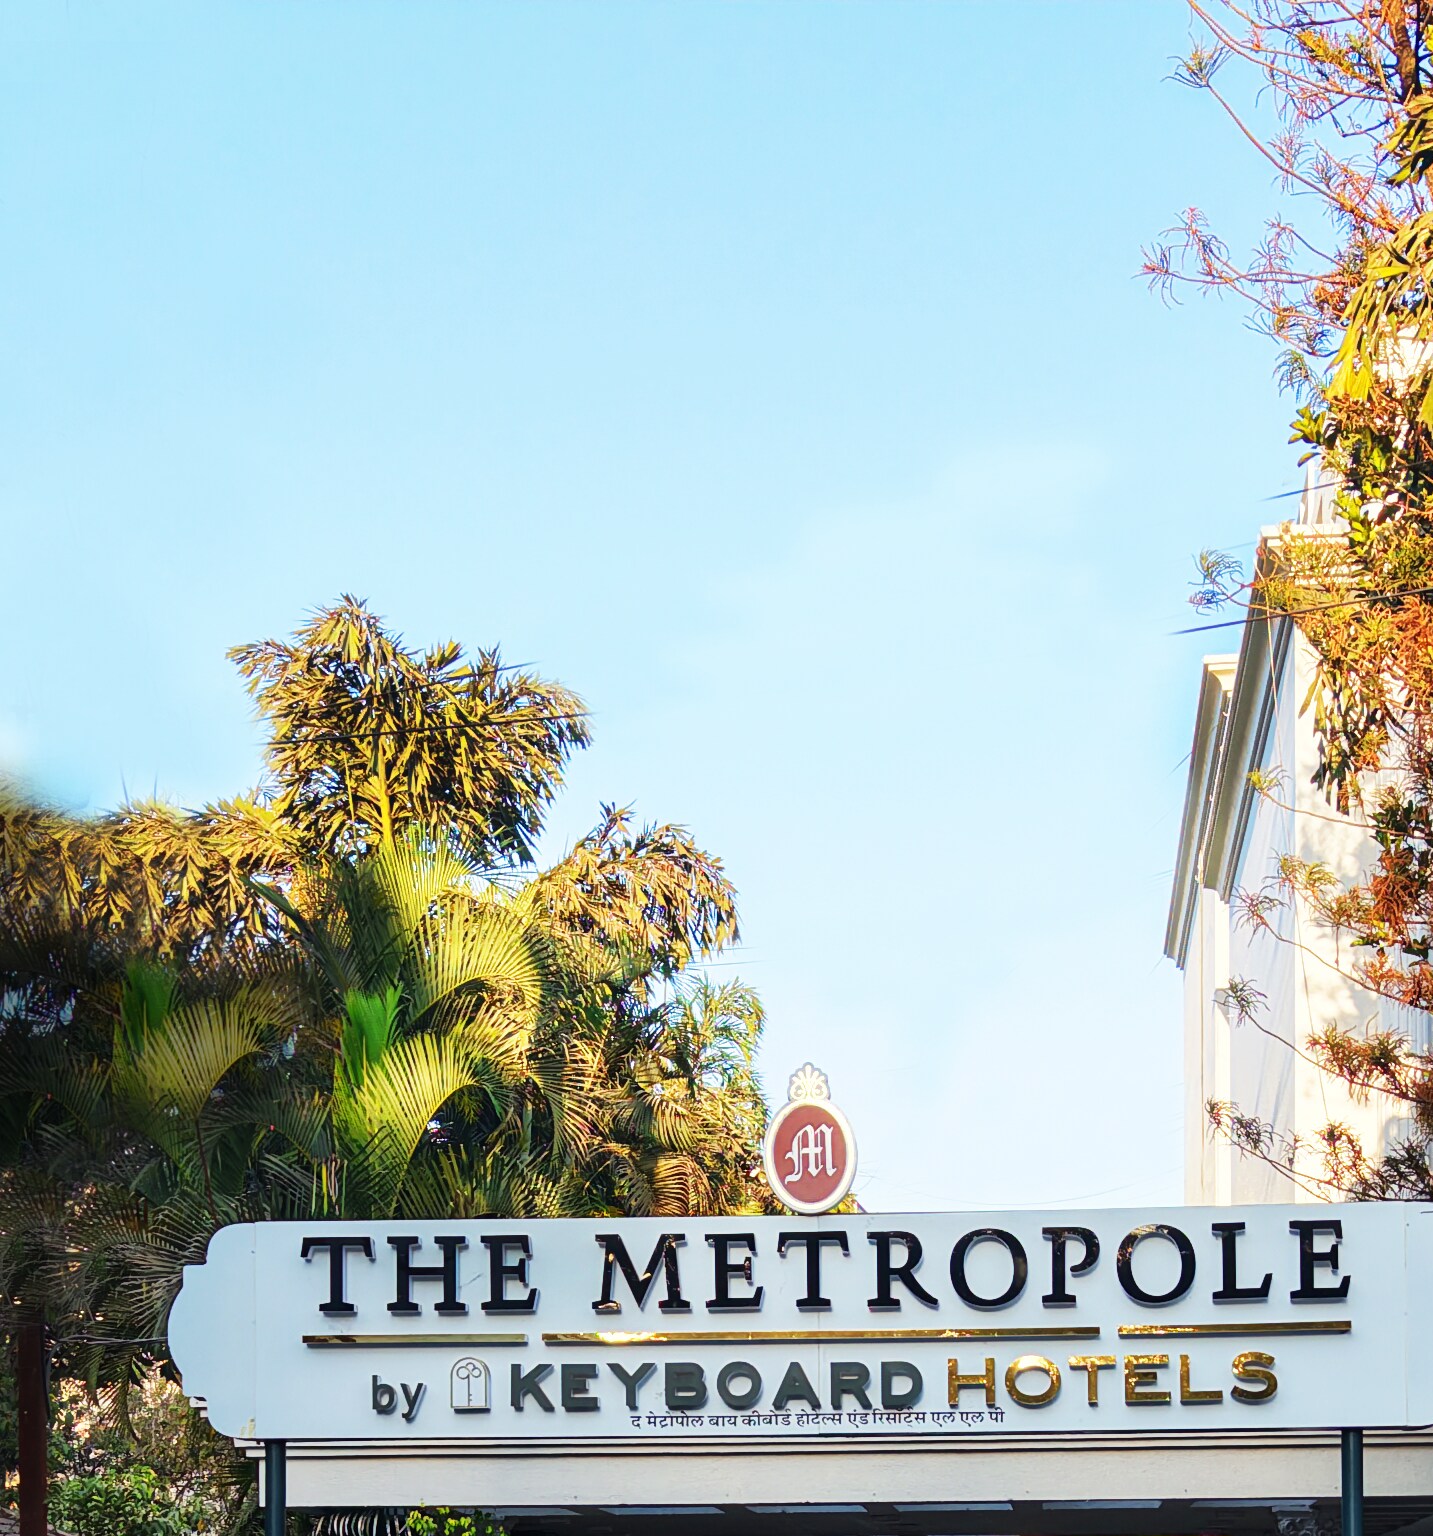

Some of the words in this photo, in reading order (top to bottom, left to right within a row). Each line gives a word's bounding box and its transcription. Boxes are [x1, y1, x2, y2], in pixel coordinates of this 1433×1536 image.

[300, 1235, 541, 1314] THE
[591, 1219, 1352, 1313] METROPOLE
[371, 1374, 426, 1422] by
[510, 1359, 923, 1413] KEYBOARD
[946, 1351, 1278, 1408] HOTELS
[707, 1415, 738, 1427] बाय
